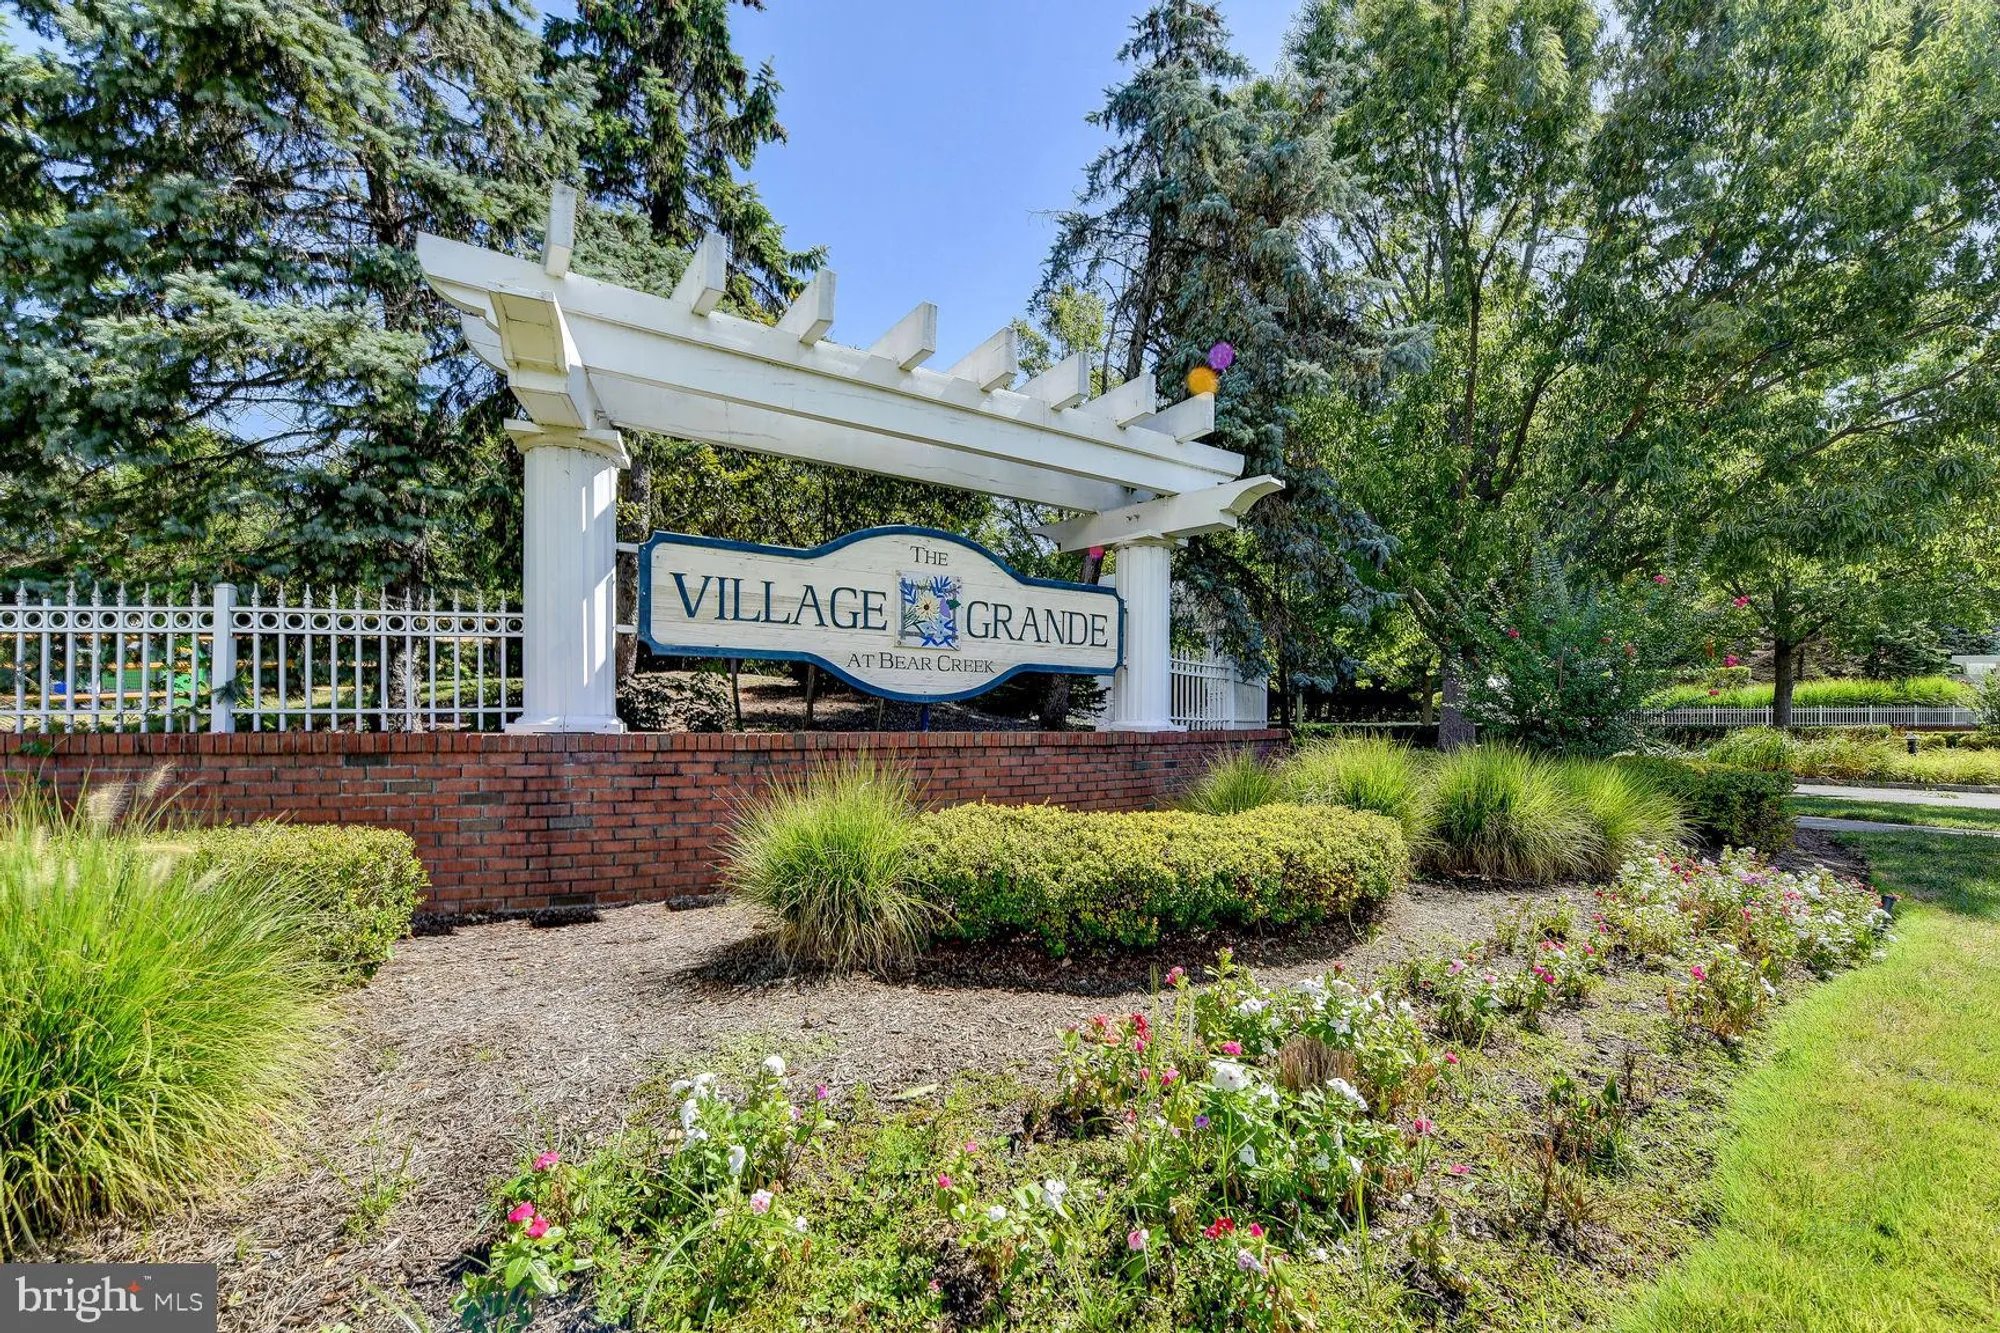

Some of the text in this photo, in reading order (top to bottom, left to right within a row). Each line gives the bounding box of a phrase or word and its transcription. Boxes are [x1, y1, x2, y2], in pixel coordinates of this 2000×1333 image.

[669, 572, 1108, 648] VILLAGE GRANDE
[847, 652, 996, 674] AT BEAR CREEK
